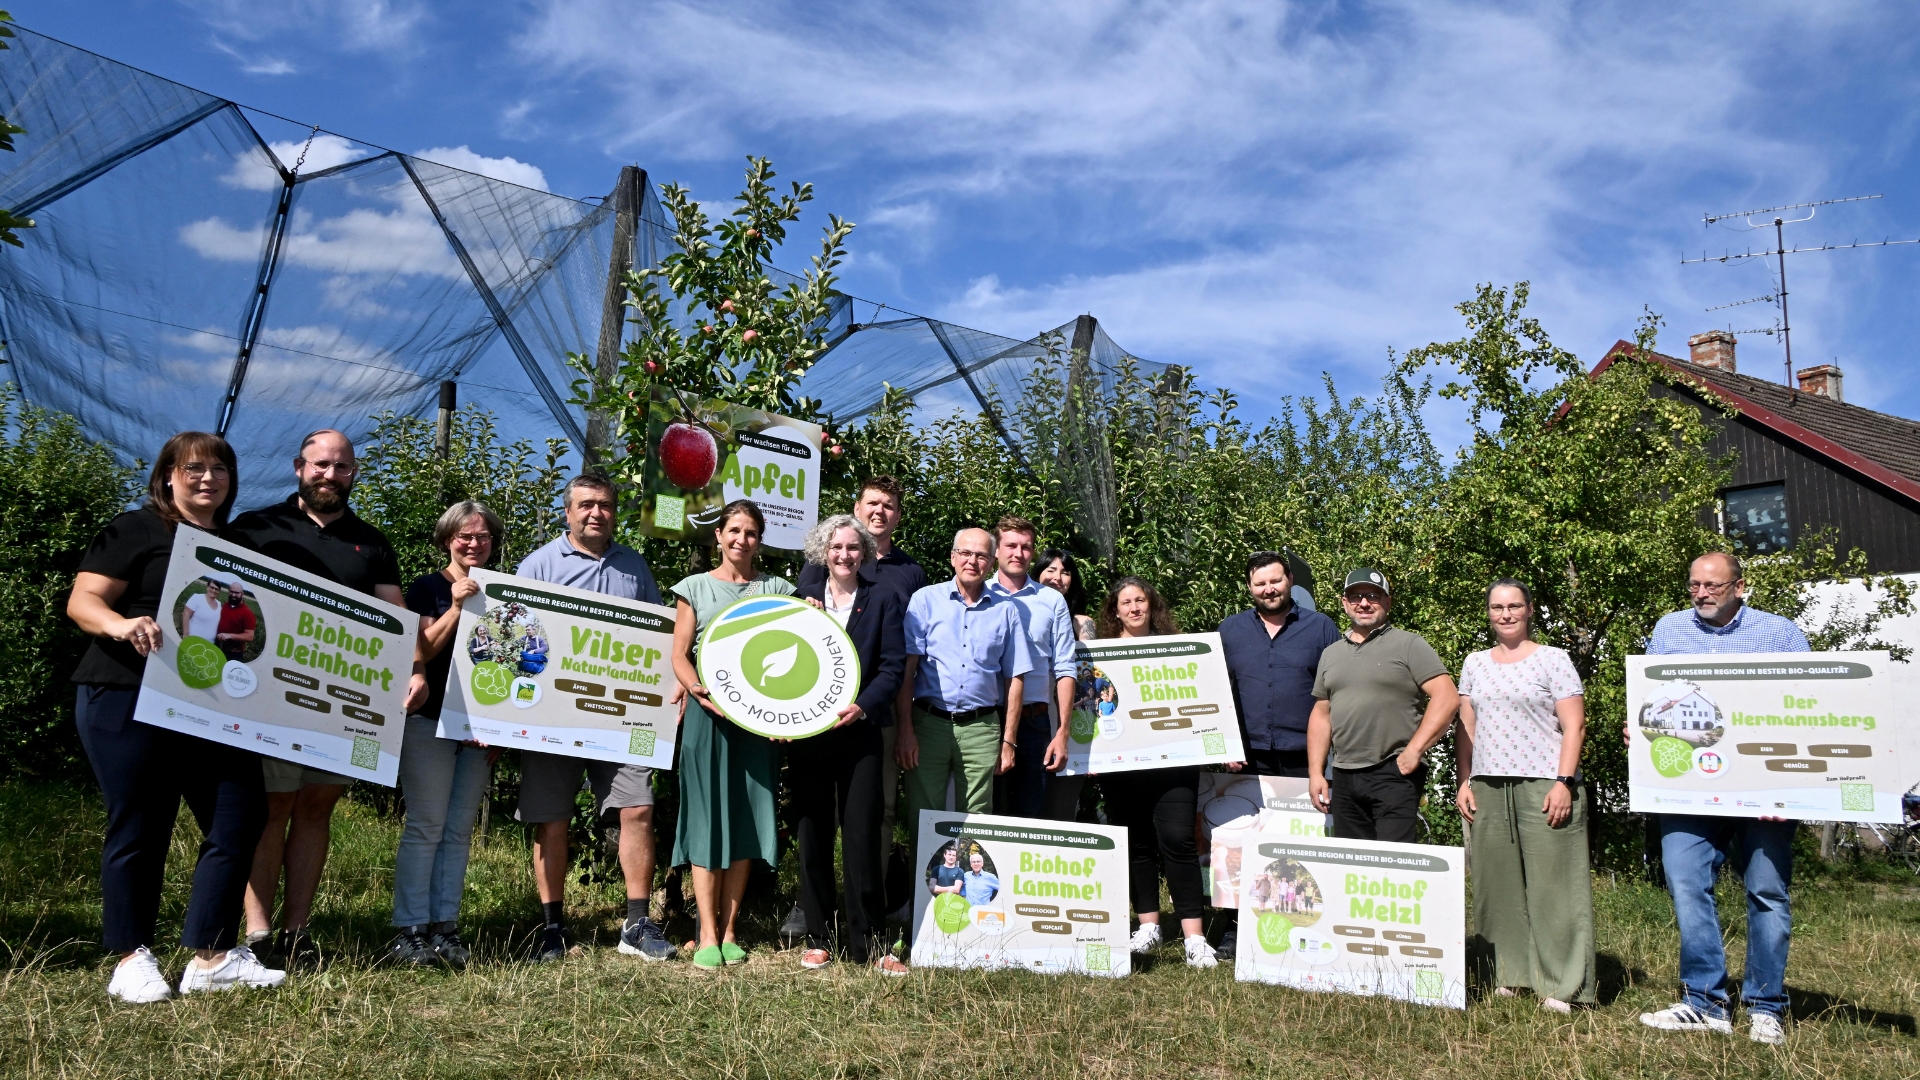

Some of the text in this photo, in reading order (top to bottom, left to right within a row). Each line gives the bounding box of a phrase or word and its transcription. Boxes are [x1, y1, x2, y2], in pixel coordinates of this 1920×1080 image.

[739, 434, 808, 456] Hier wachsen für euch:
[719, 443, 806, 501] Äpfel
[768, 503, 788, 512] UNSERER
[788, 507, 804, 515] REGION
[214, 556, 387, 625] AUS UNSERER REGION IN BESTER BIO-QUALITÄT
[502, 589, 517, 598] AUS
[518, 592, 550, 605] UNSERER
[551, 599, 579, 610] REGION
[589, 607, 614, 618] BESTER
[614, 612, 662, 627] BIO-QUALITÄT
[297, 611, 384, 660] Biohof
[570, 625, 662, 669] Vilser
[1157, 644, 1197, 654] BIO-QUALITÄT
[276, 632, 394, 692] Deinhart
[560, 656, 662, 686] Naturlandhof
[1677, 668, 1712, 676] UNSERER
[1714, 668, 1745, 676] REGION
[1788, 666, 1849, 675] BIO-QUALITÄT
[282, 672, 312, 686] KARTOFFELN
[715, 635, 846, 725] ÖKO-MODELLREGIONEN
[1131, 662, 1198, 684] Biohof
[334, 689, 362, 702] KNOBLAUCH
[572, 683, 588, 692] ÄPFEL
[1140, 683, 1198, 703] Böhm
[298, 697, 318, 707] INGWER
[584, 702, 618, 712] ZWETSCHGEN
[629, 694, 648, 702] BIRNEN
[1783, 695, 1818, 710] Der
[1731, 711, 1876, 731] Hermannsberg
[1271, 800, 1316, 810] Hier wächs
[963, 828, 993, 836] UNSERER
[994, 830, 1020, 838] REGION
[1028, 833, 1052, 841] BESTER
[1052, 835, 1099, 845] BIO-QUALITÄT
[1019, 851, 1096, 878] Biohof
[1287, 848, 1316, 857] UNSERER
[1318, 851, 1344, 859] REGION
[1354, 854, 1379, 862] BESTER
[1380, 856, 1430, 866] BIO-QUALITÄT
[1013, 874, 1102, 901] Lammel
[1345, 873, 1428, 901] Biohof
[1018, 906, 1056, 914] HAFERFLOCKEN
[1072, 912, 1104, 920] DINKEL-REIS
[1350, 897, 1421, 925] Melzl
